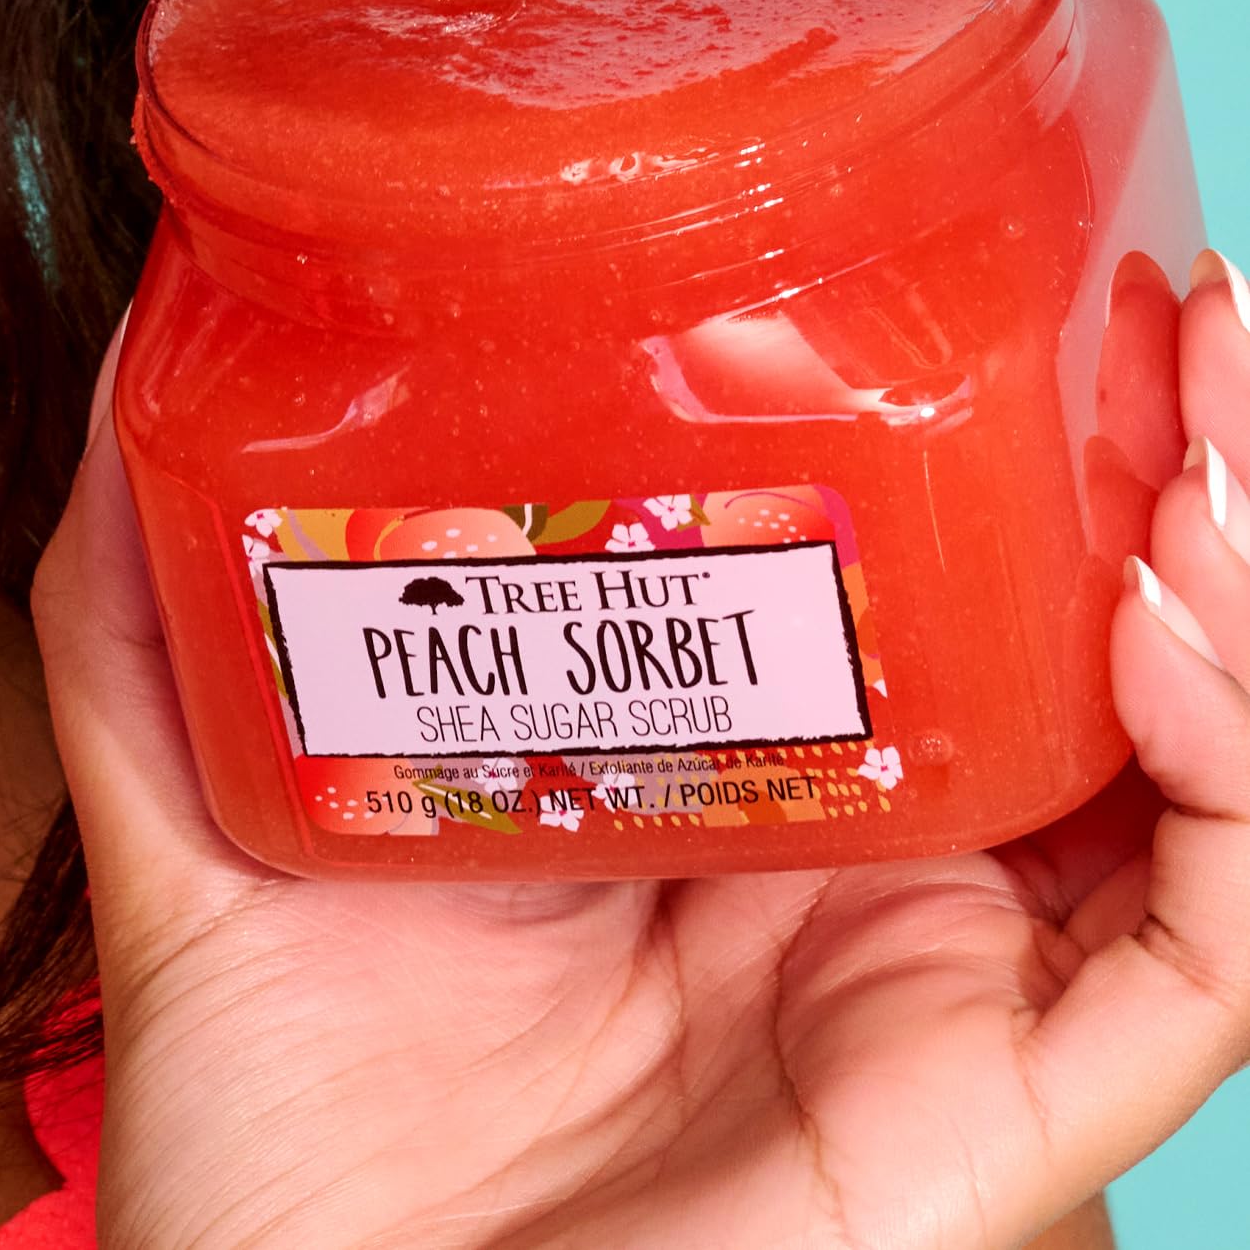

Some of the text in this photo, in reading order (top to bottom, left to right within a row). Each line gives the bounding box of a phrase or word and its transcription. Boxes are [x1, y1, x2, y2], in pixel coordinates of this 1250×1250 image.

[363, 609, 757, 699] PEACH SORBET
[416, 695, 733, 742] SHEA SUGAR SCRUB
[393, 764, 460, 783] Gommage
[463, 767, 479, 779] au
[482, 764, 520, 779] Sucre
[523, 764, 534, 777] et
[580, 762, 586, 778] /
[589, 758, 654, 776] Exfoliante
[657, 757, 673, 773] de
[677, 755, 720, 772] Azúcar
[725, 754, 742, 769] de
[746, 752, 785, 768] Karité
[366, 775, 818, 818] 510 g (18 OZ.) NET WT. / POIDS NET
